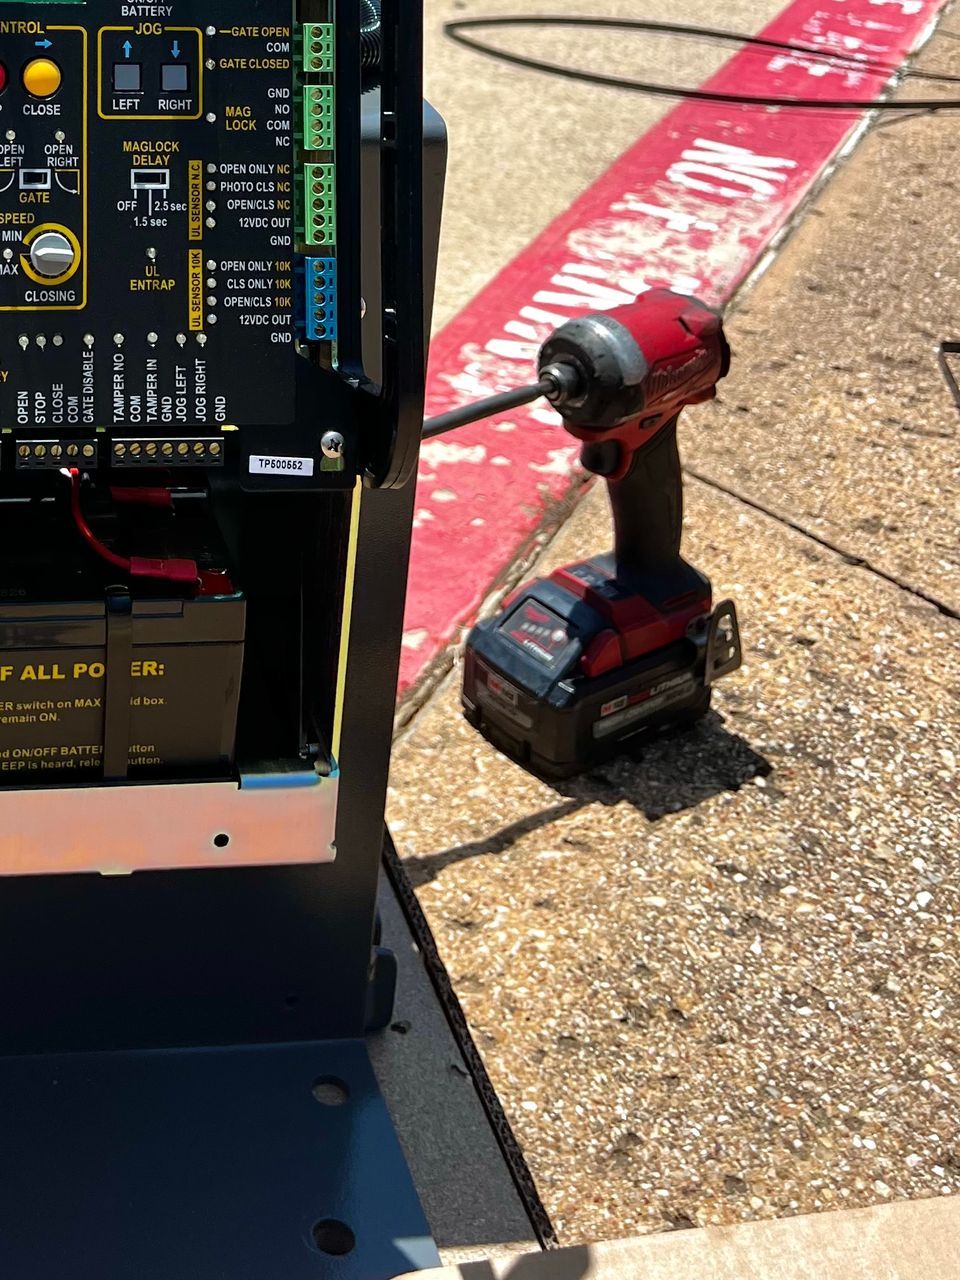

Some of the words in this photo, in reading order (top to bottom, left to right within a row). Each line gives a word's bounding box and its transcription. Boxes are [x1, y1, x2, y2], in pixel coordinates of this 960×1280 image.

[121, 6, 173, 17] BATTERY
[135, 23, 162, 35] JOG
[231, 27, 260, 36] GATE
[262, 27, 289, 37] OPEN
[220, 59, 247, 68] GATE
[249, 59, 289, 68] CLOSED
[23, 105, 61, 115] CLOSE
[226, 107, 251, 117] MAG
[226, 120, 256, 130] LOCK
[123, 141, 179, 152] MAGLOCK
[133, 155, 170, 165] DELAY
[220, 164, 247, 174] OPEN
[249, 164, 274, 174] ONLY
[277, 164, 290, 174] NC
[220, 182, 254, 192] PHOTO
[256, 181, 275, 191] CLS
[277, 182, 290, 192] NC
[227, 199, 275, 209] OPEN/CLS
[277, 199, 291, 209] NC
[146, 266, 160, 276] UL
[130, 280, 175, 290] ENTRAP
[114, 353, 124, 368] NO
[114, 371, 124, 422] TAMPER
[18, 391, 28, 424] OPEN
[35, 392, 45, 424] STOP
[52, 384, 63, 423] CLOSE
[21, 664, 65, 680] ALL
[74, 661, 165, 678] POER:
[16, 701, 54, 710] switch
[75, 699, 101, 707] MAX
[12, 748, 61, 758] ON/OFF
